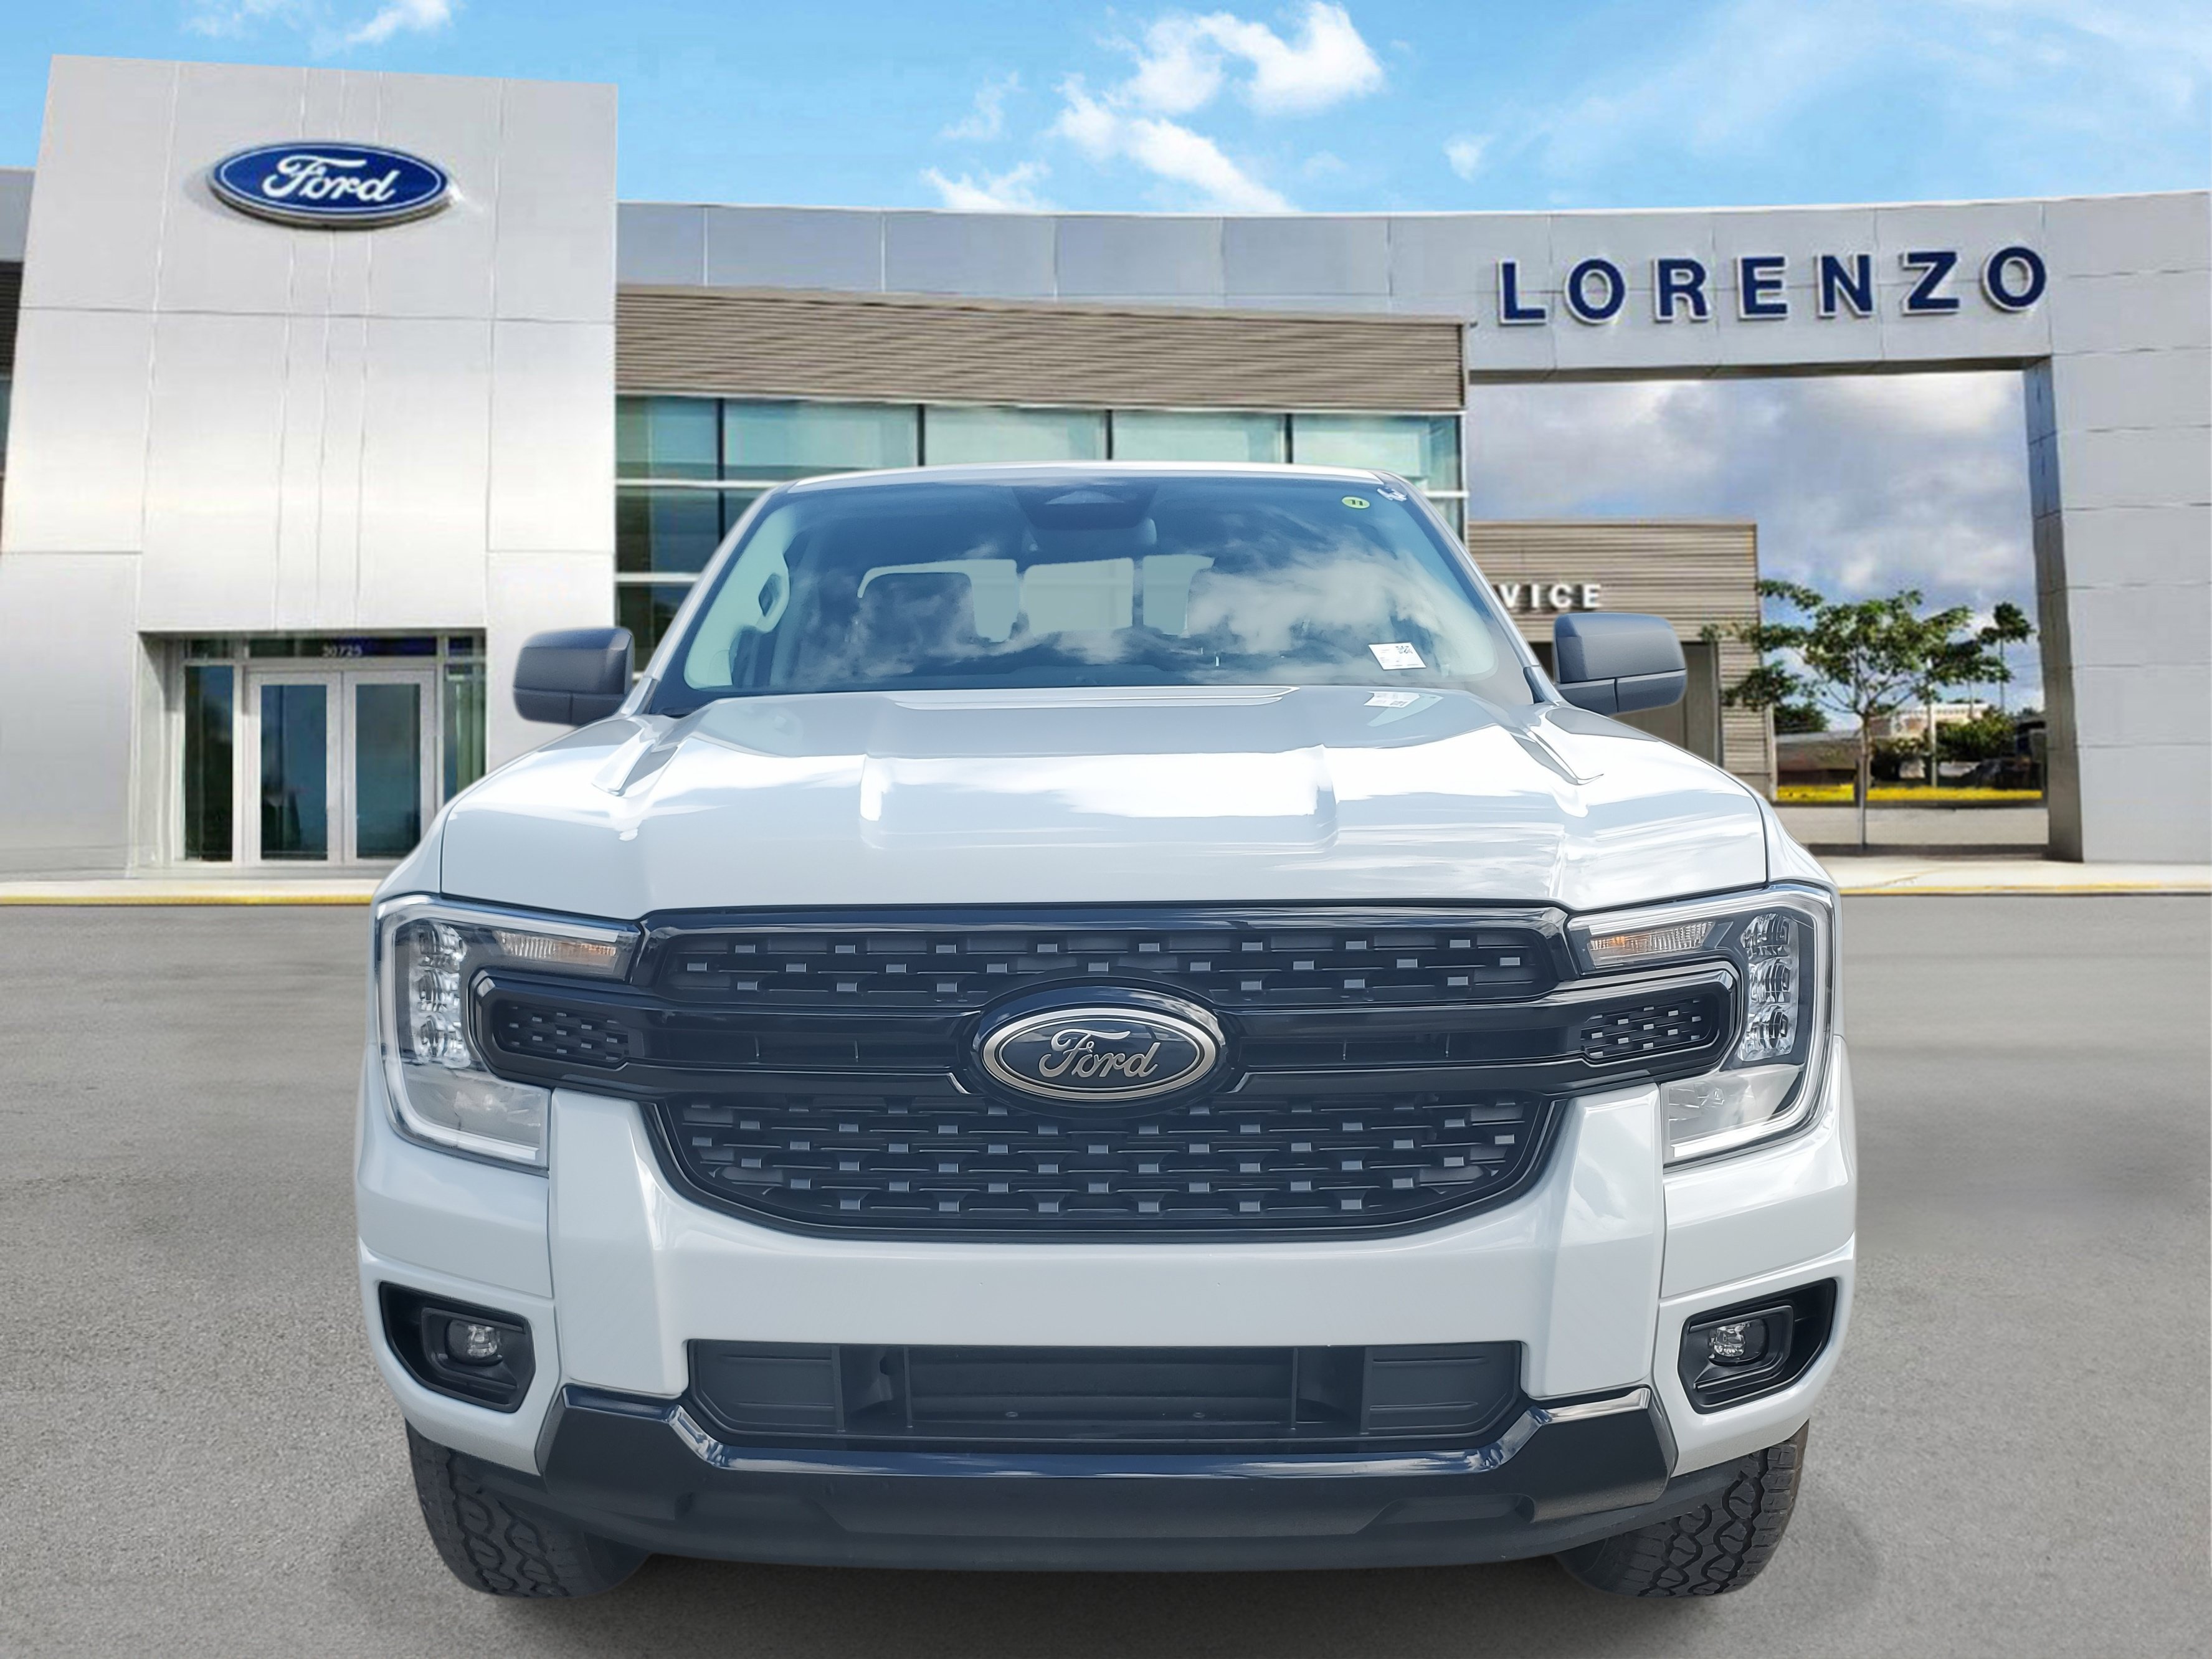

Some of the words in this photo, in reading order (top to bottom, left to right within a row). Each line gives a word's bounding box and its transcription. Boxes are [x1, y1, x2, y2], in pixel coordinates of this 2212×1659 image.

[263, 155, 400, 202] Ford
[1497, 247, 2047, 325] LORENZO
[1039, 1028, 1161, 1078] Ford
